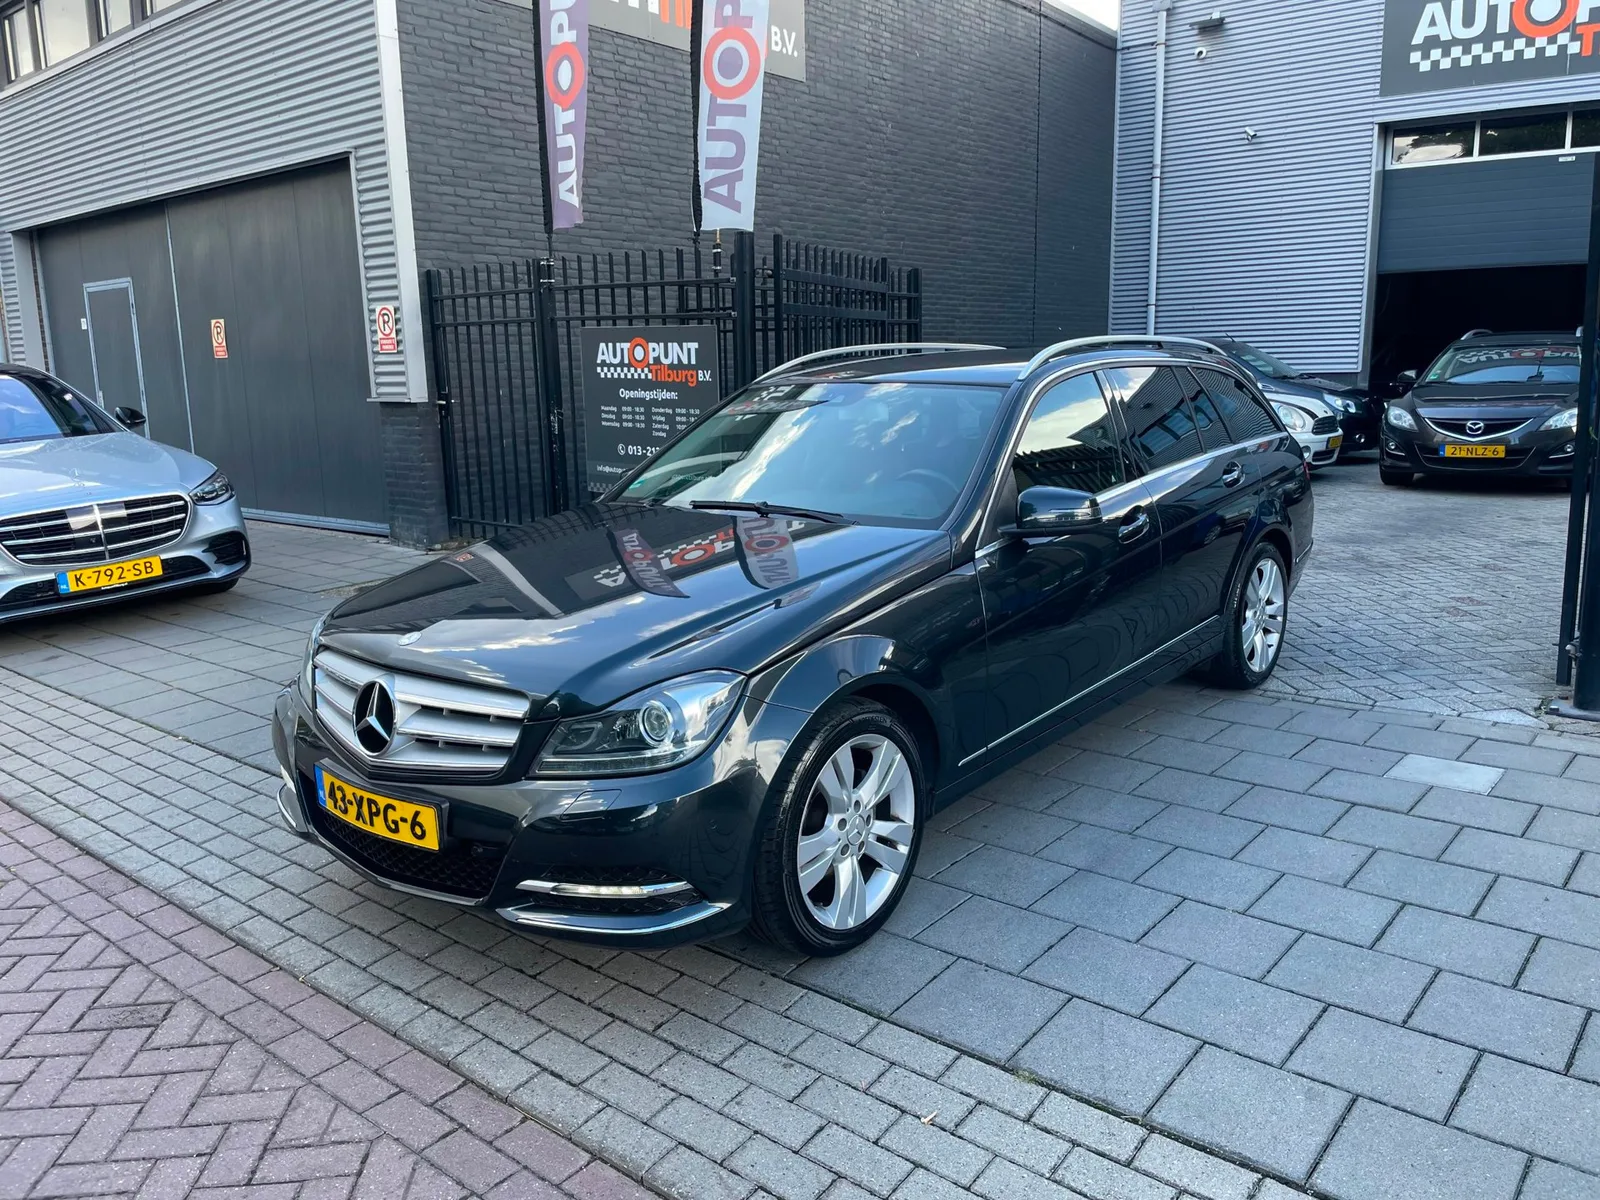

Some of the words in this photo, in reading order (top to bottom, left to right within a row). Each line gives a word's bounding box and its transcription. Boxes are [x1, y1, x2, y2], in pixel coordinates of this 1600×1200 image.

[770, 25, 798, 57] B.V.
[546, 0, 585, 208] AUTOP
[597, 337, 698, 369] AUTOPUNT
[650, 365, 697, 387] Tilburg
[698, 370, 712, 382] B.V.
[619, 388, 678, 401] Openingstijden:
[627, 444, 660, 457] 013-21
[1450, 446, 1499, 456] 21-NLZ-6
[74, 561, 154, 588] K-792-SB
[328, 781, 426, 840] 43-XPG-6
